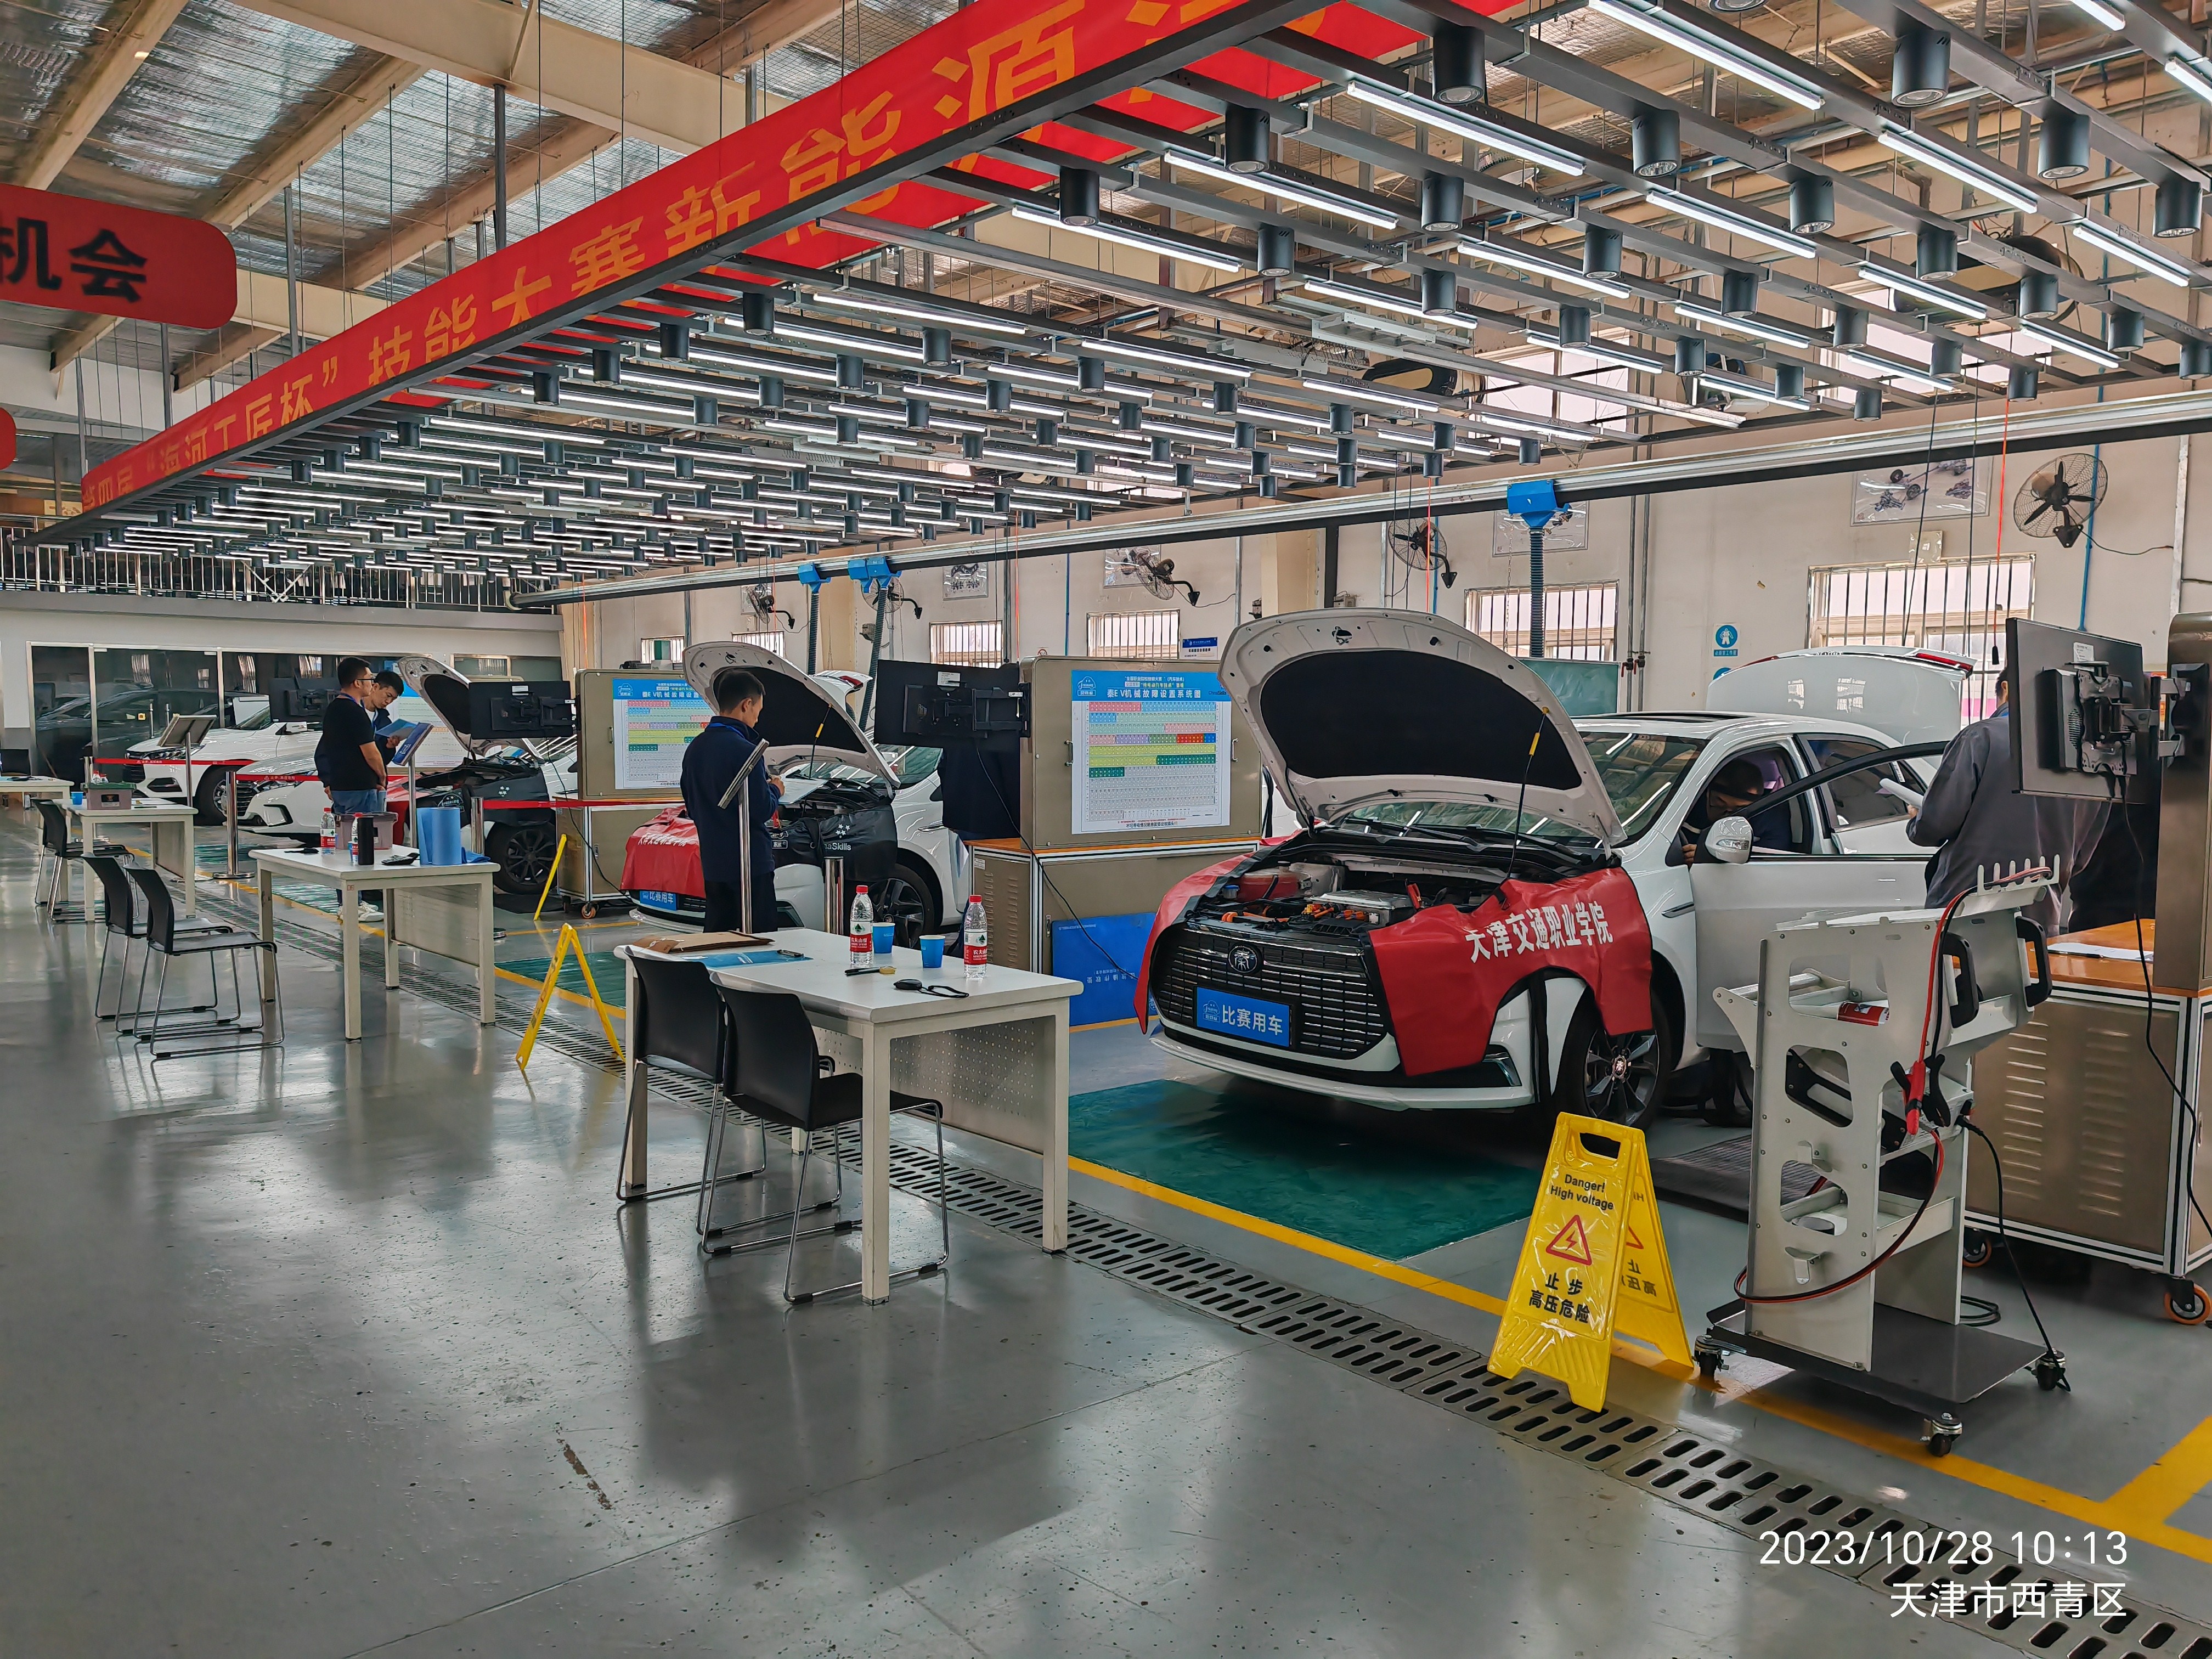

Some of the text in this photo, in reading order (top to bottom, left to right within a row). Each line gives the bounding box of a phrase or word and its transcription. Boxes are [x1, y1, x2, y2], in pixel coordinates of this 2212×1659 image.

[0, 217, 148, 303] 机会
[650, 890, 674, 905] 比赛用车
[1463, 900, 1613, 963] 天津交通职业学院
[1222, 1004, 1283, 1036] 比赛用车
[1550, 1185, 1613, 1210] High voltage
[1565, 1174, 1605, 1193] Danger!
[1529, 1289, 1590, 1324] 高压危险
